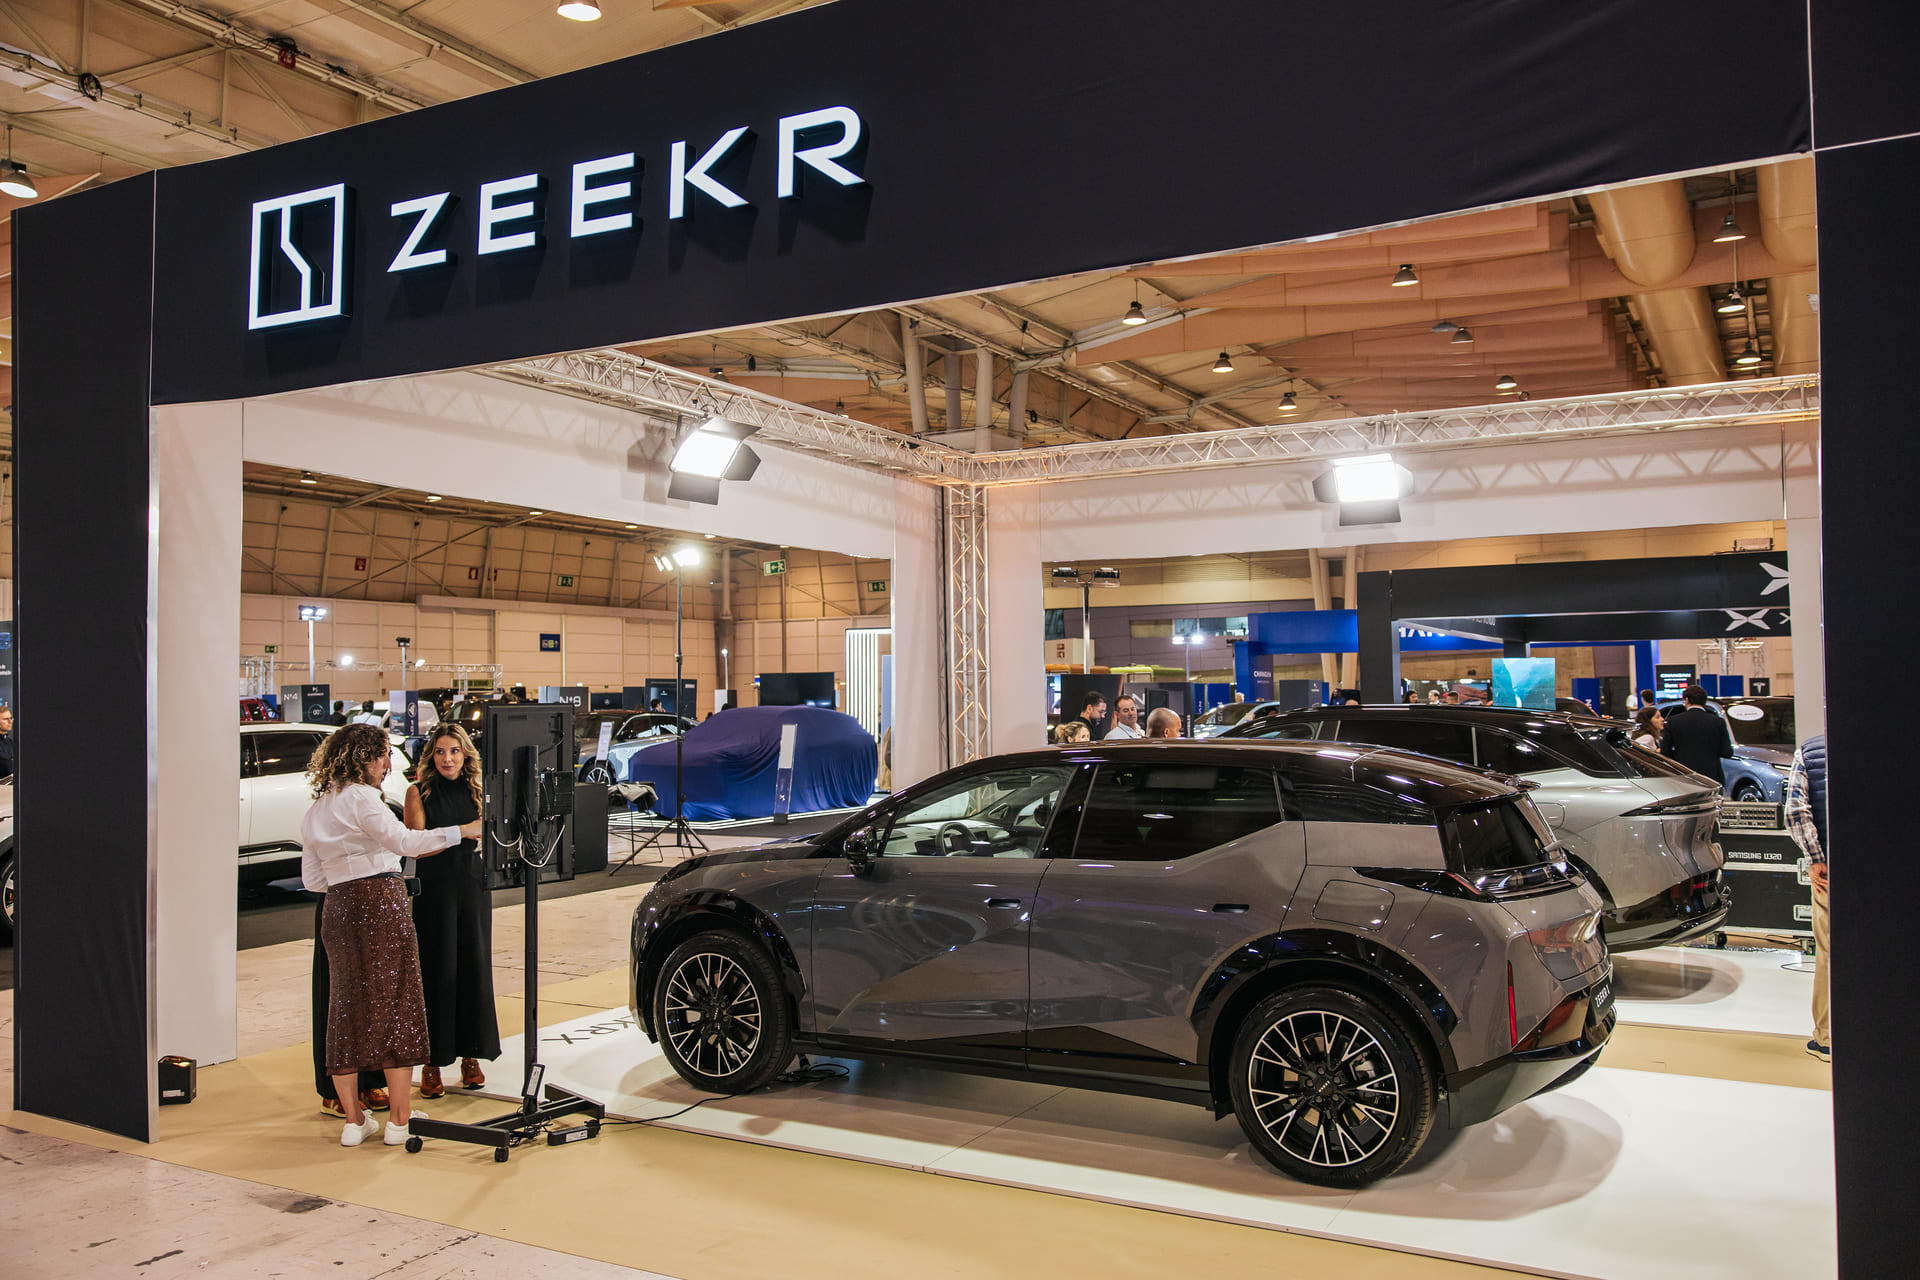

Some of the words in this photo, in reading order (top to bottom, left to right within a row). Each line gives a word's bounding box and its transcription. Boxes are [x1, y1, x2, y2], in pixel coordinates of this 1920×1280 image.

[387, 105, 866, 273] ZEEKR
[1728, 851, 1762, 860] SAMSUNG
[1763, 852, 1783, 861] U320
